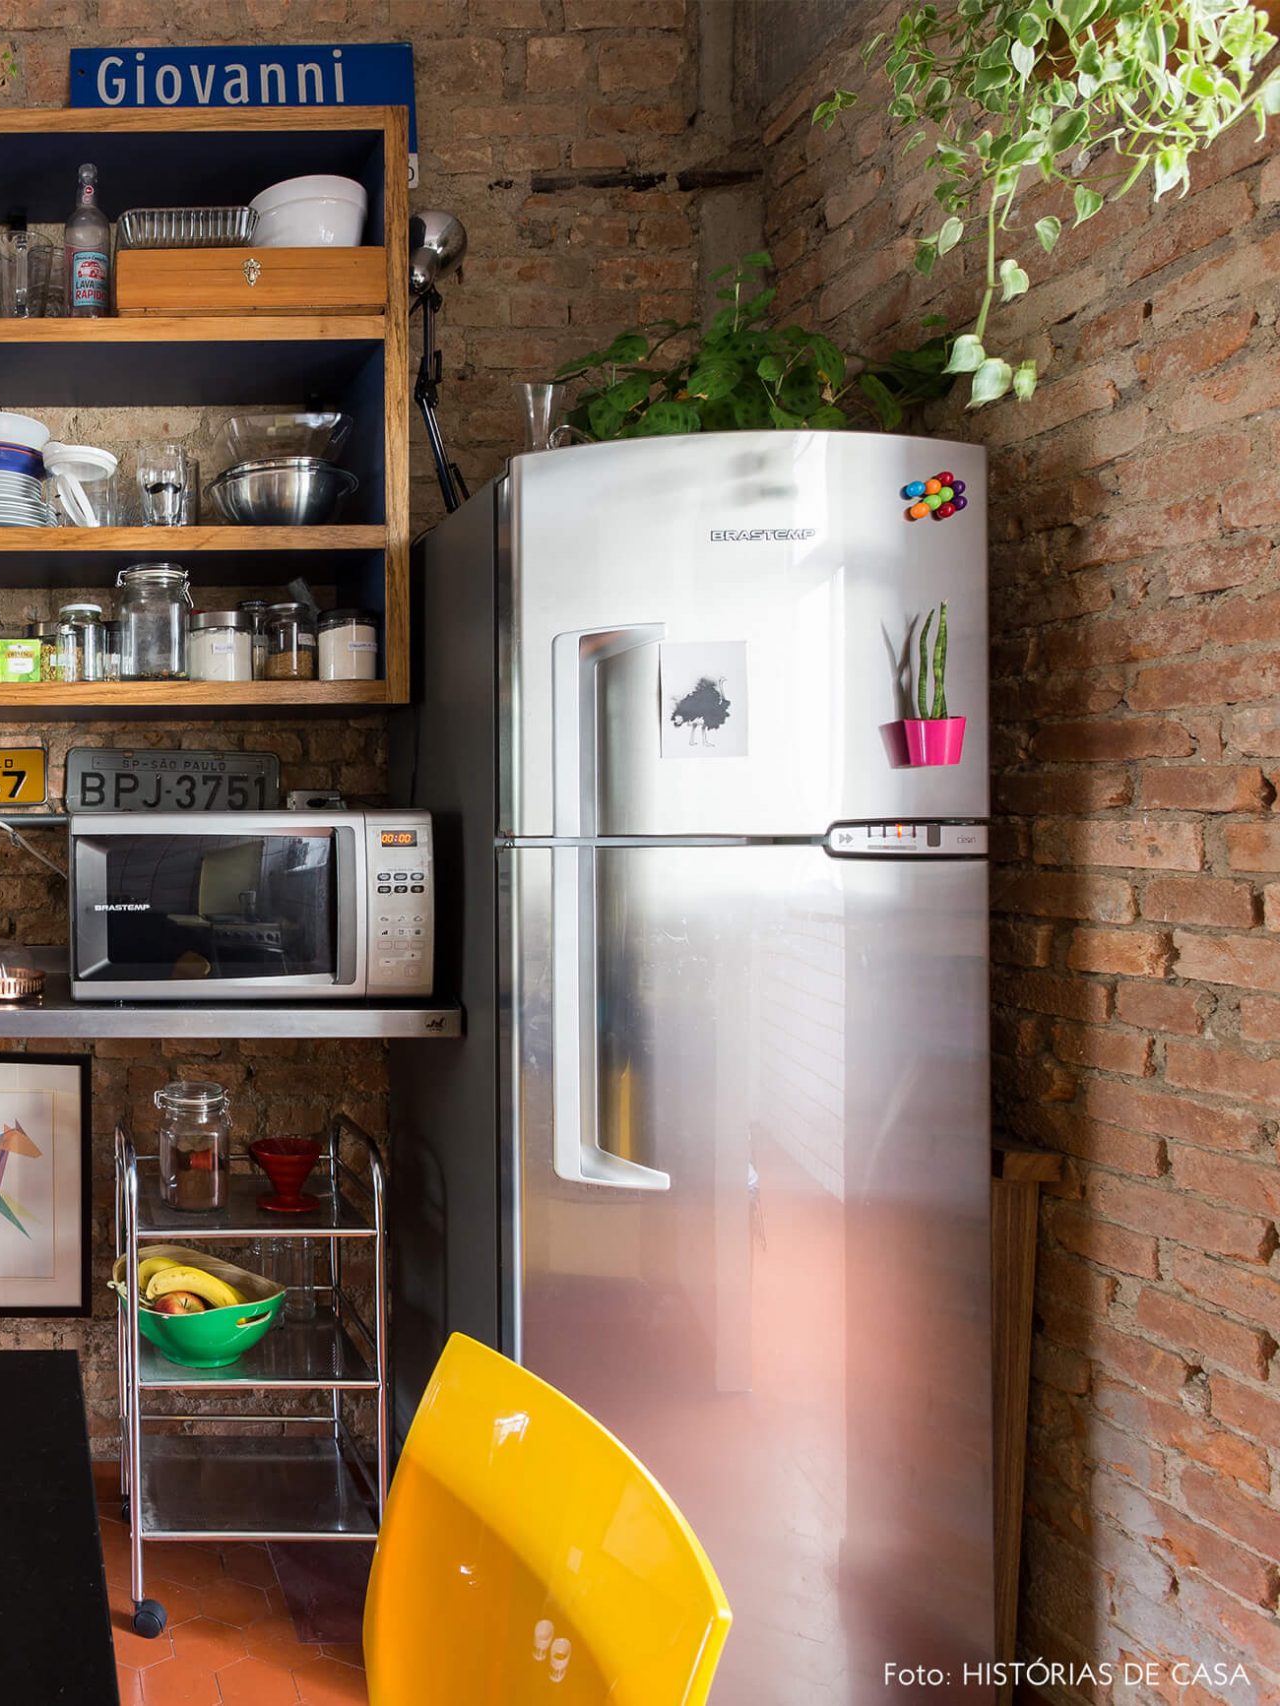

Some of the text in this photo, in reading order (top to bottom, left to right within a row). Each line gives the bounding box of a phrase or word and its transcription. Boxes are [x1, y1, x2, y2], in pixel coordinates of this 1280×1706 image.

[97, 49, 345, 105] Giovanni
[75, 280, 96, 289] LAVA
[710, 529, 816, 541] BRASTEMP
[184, 760, 226, 771] PAULO
[80, 771, 266, 811] BPJ-3751
[381, 833, 412, 843] 00:00
